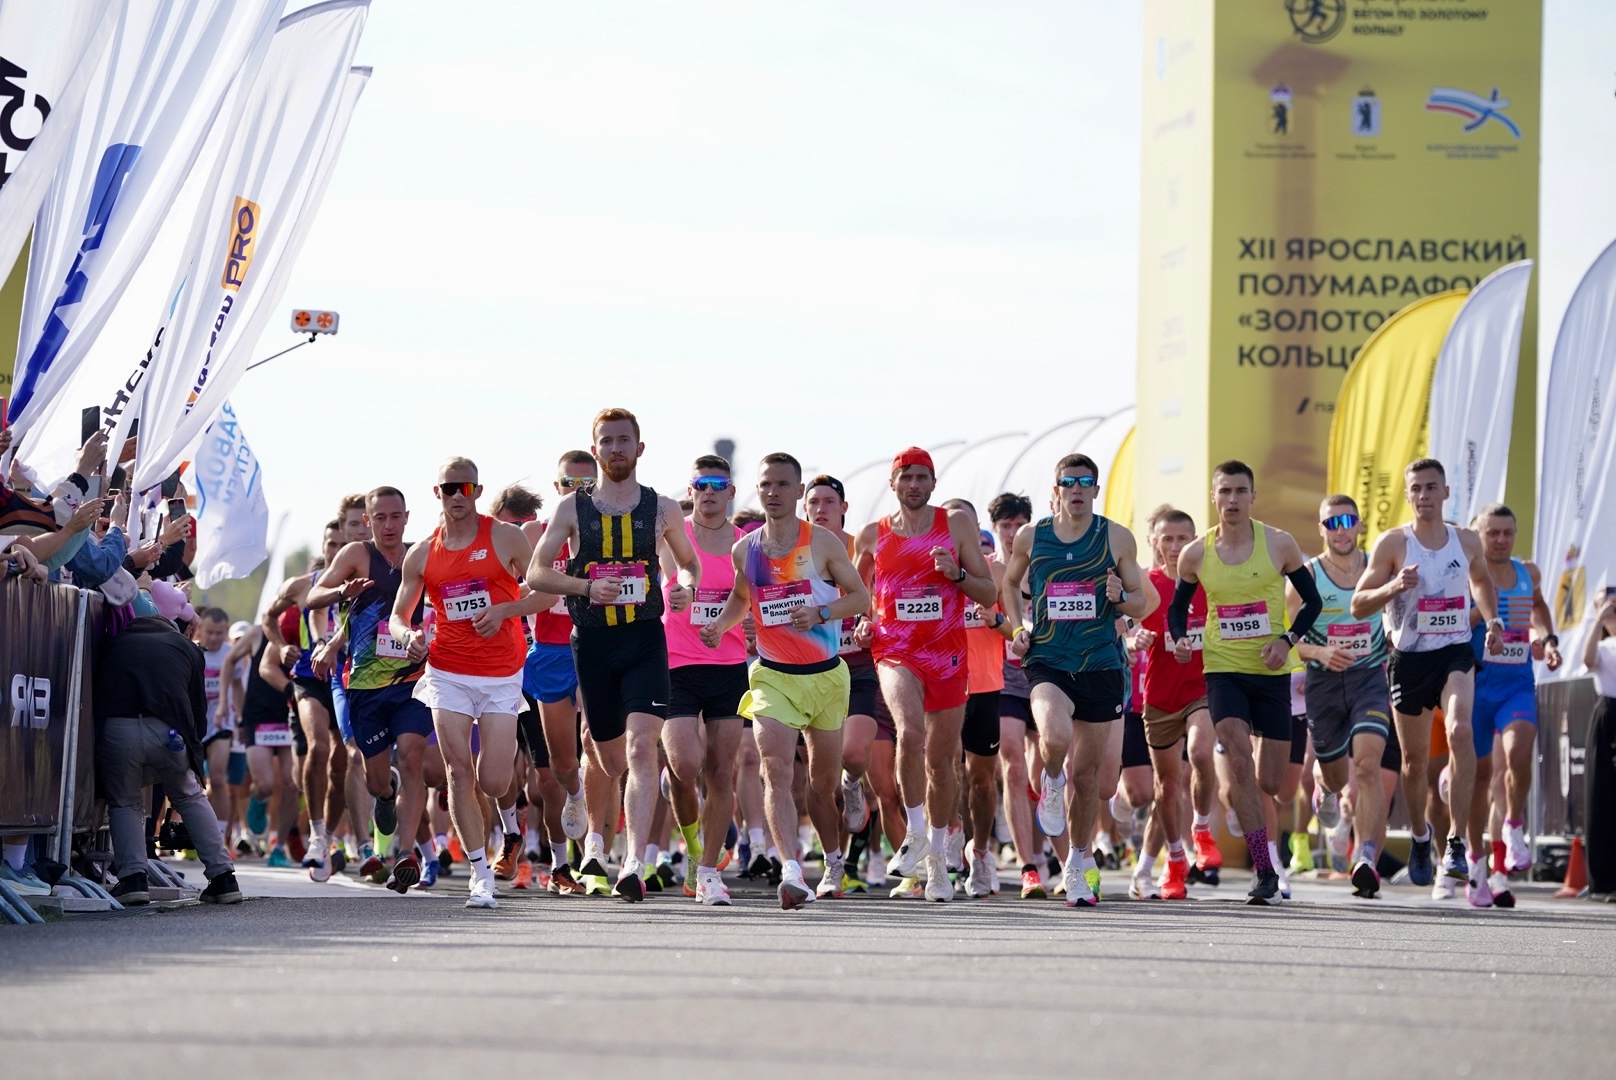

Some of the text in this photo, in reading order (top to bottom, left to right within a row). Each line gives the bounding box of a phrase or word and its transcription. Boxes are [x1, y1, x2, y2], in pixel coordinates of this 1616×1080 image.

[226, 205, 255, 287] PRO
[1238, 234, 1527, 262] XII ЯРОСЛАВСКИЙ
[1238, 308, 1397, 333] «ЗОЛОТО
[456, 597, 487, 612] 1753
[769, 599, 805, 610] НИКИТИН
[907, 602, 939, 613] 2228
[1059, 601, 1093, 611] 2382
[1229, 620, 1260, 632] 1958
[1430, 615, 1457, 626] 2515
[1188, 633, 1203, 643] 71
